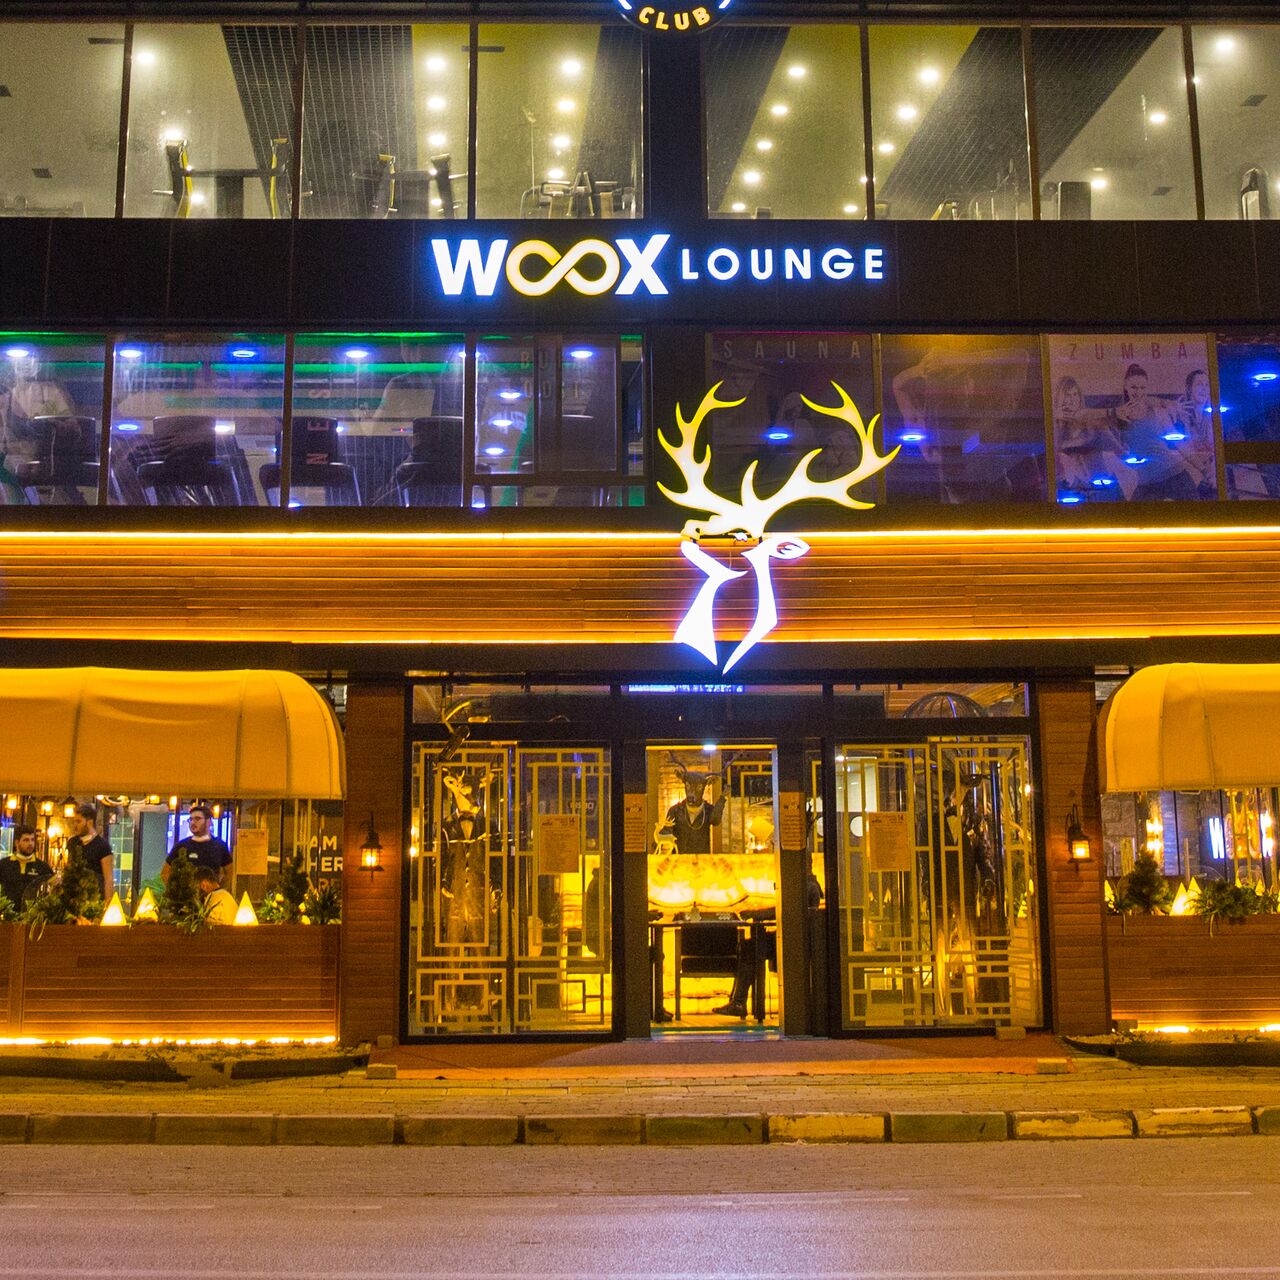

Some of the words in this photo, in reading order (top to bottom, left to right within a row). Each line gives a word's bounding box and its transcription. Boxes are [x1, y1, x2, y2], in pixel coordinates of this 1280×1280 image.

[638, 5, 712, 31] CLUB
[431, 234, 671, 297] WOOX
[681, 248, 884, 281] LOUNGE
[723, 339, 861, 360] SAUNA
[1069, 341, 1188, 360] ZUMBA
